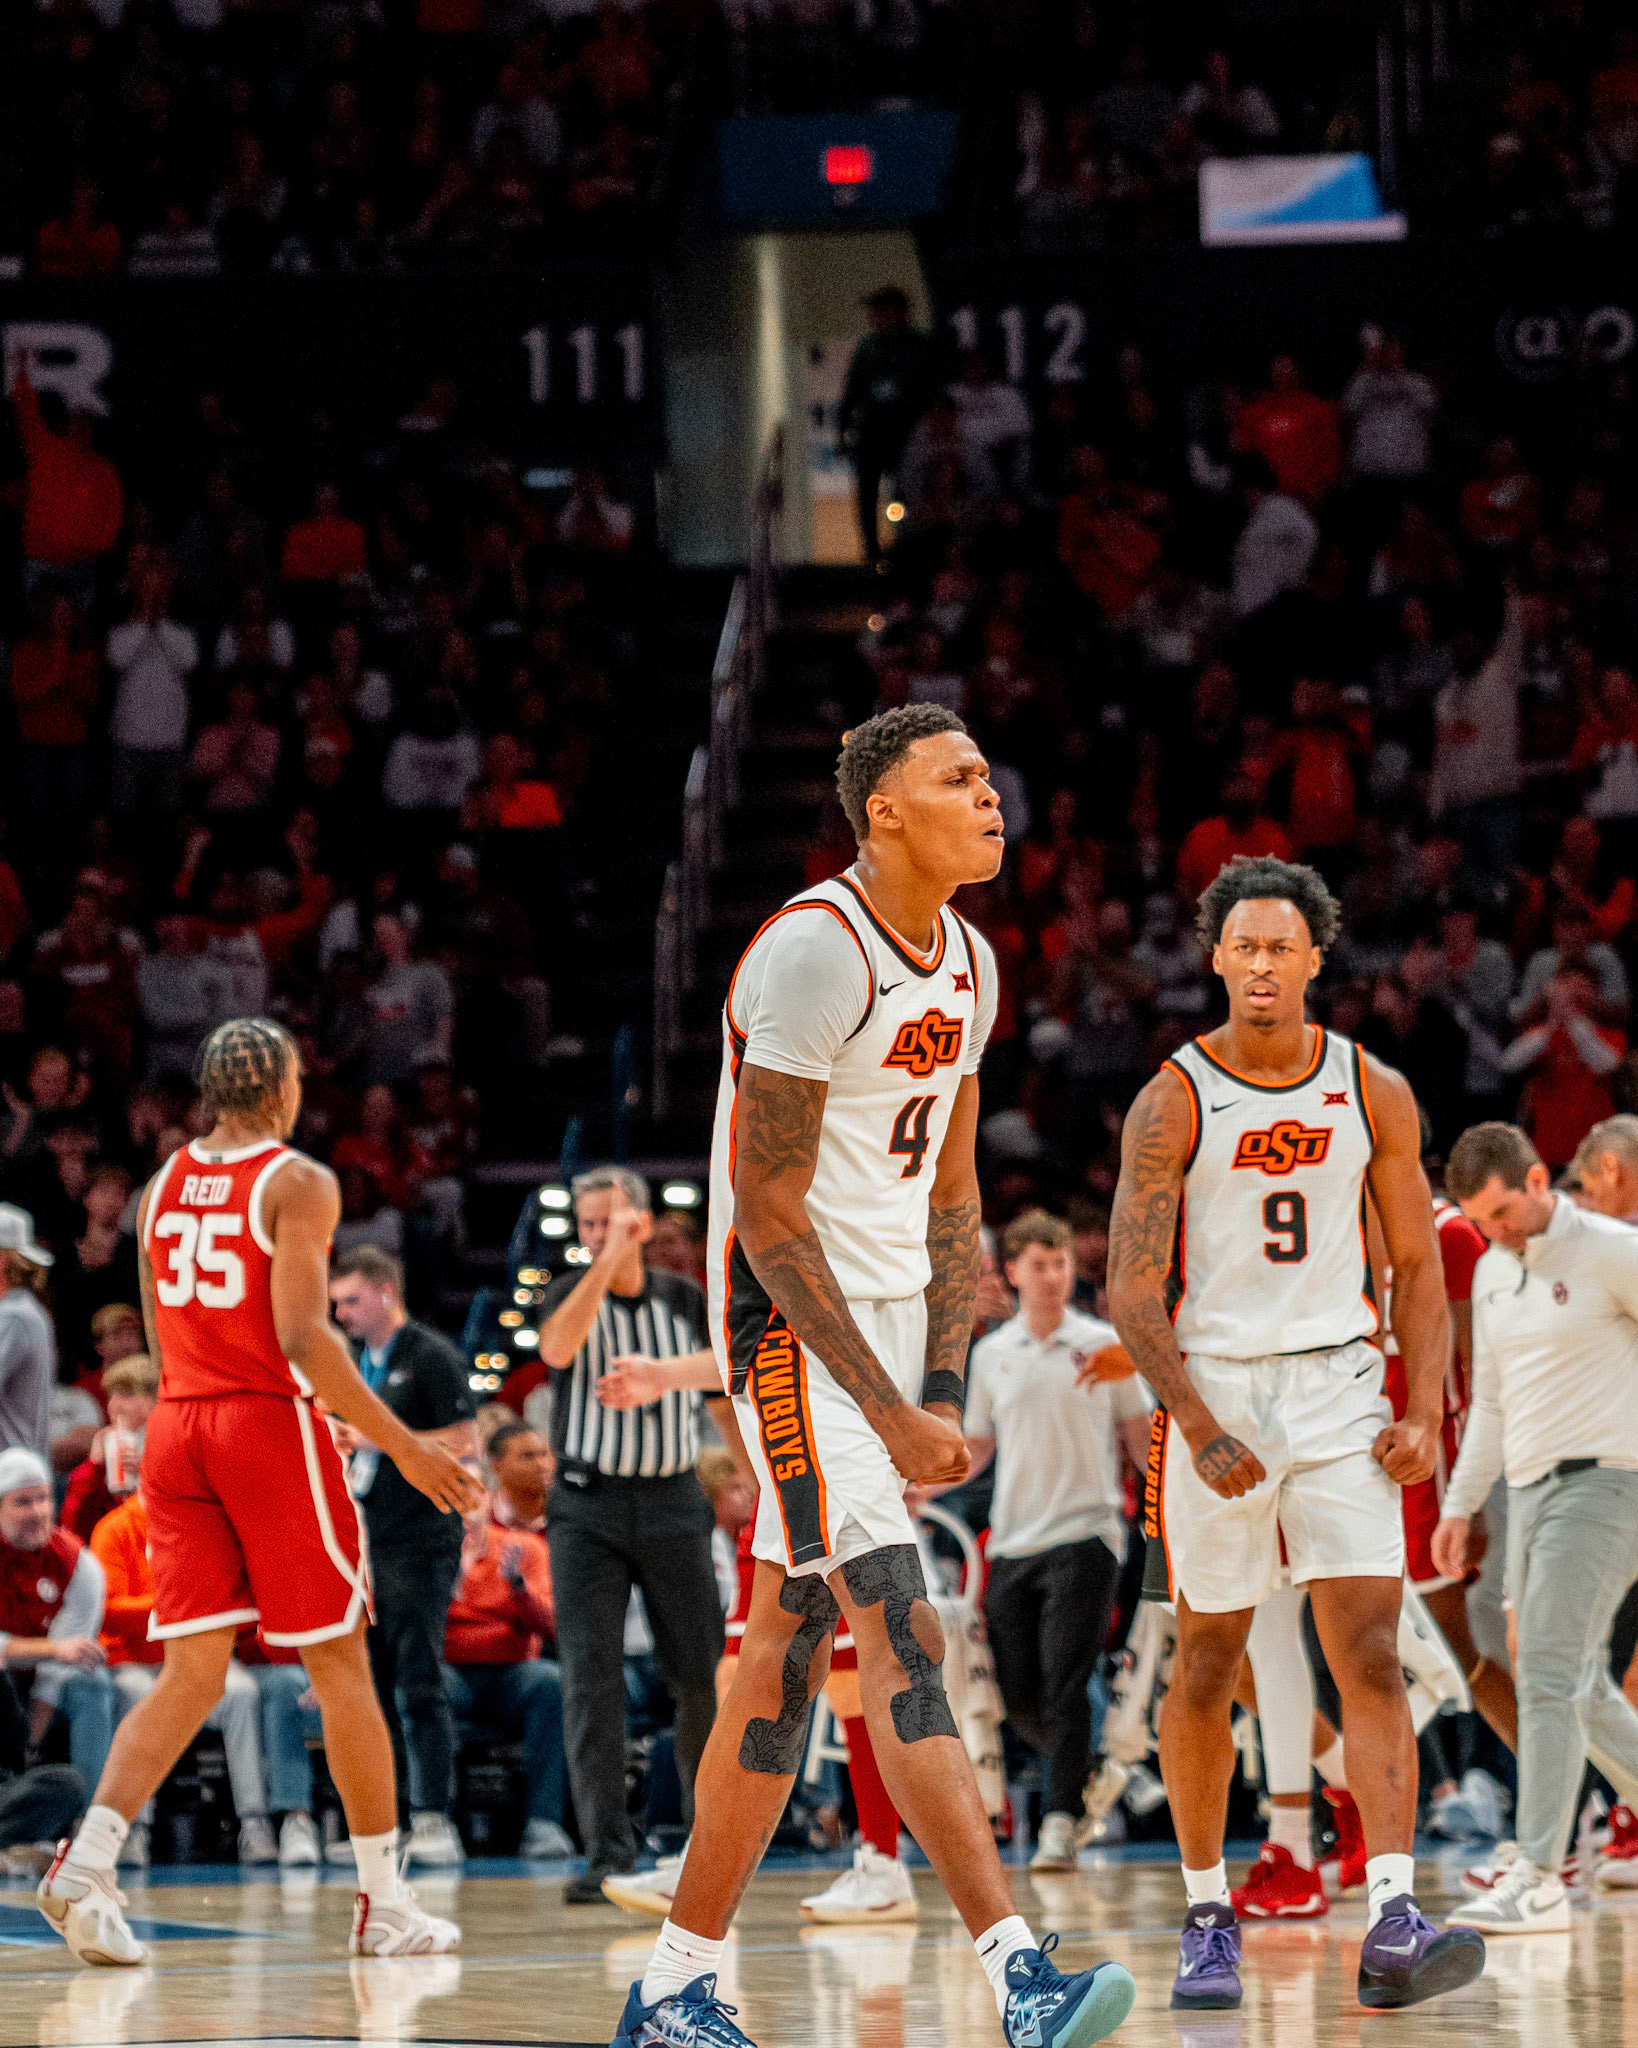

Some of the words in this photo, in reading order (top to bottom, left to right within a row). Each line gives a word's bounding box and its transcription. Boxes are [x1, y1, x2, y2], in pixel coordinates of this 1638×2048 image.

[3, 321, 112, 418] R
[520, 322, 645, 404] 111
[949, 302, 1088, 382] 112
[880, 1008, 964, 1079] OSU
[888, 1095, 939, 1179] 4
[1230, 1119, 1334, 1177] OSU
[178, 1174, 234, 1206] REID
[1262, 1190, 1308, 1264] 9
[154, 1211, 246, 1309] 35
[756, 1329, 808, 1482] COWBOYS
[1144, 1407, 1166, 1538] COWBOYS
